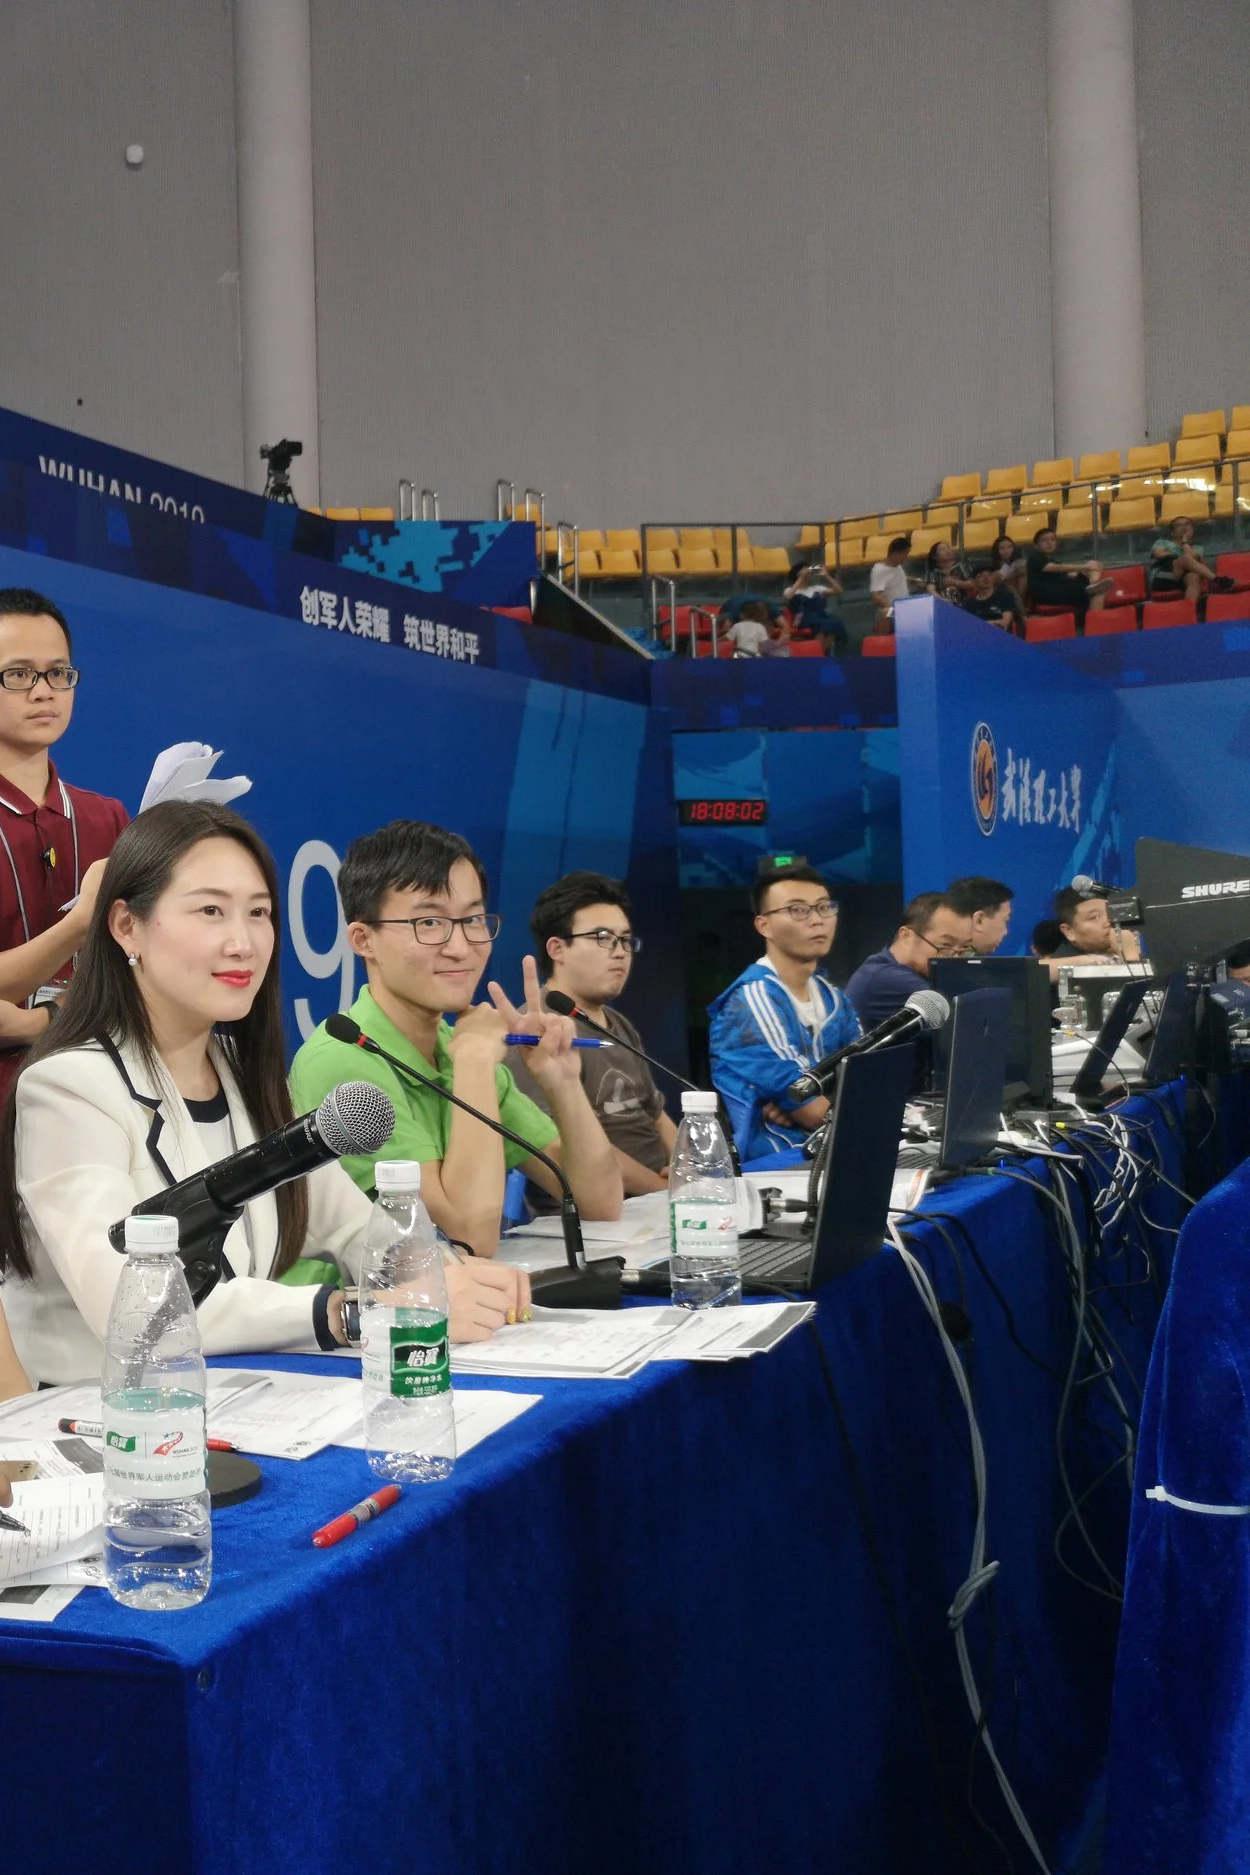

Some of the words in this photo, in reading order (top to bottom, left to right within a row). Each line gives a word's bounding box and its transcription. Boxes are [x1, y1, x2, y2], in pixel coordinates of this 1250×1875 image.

[299, 585, 391, 643] 创军人荣耀
[403, 614, 480, 665] 筑世界和平
[690, 801, 765, 821] 18:08:02
[1181, 879, 1250, 899] SHURE
